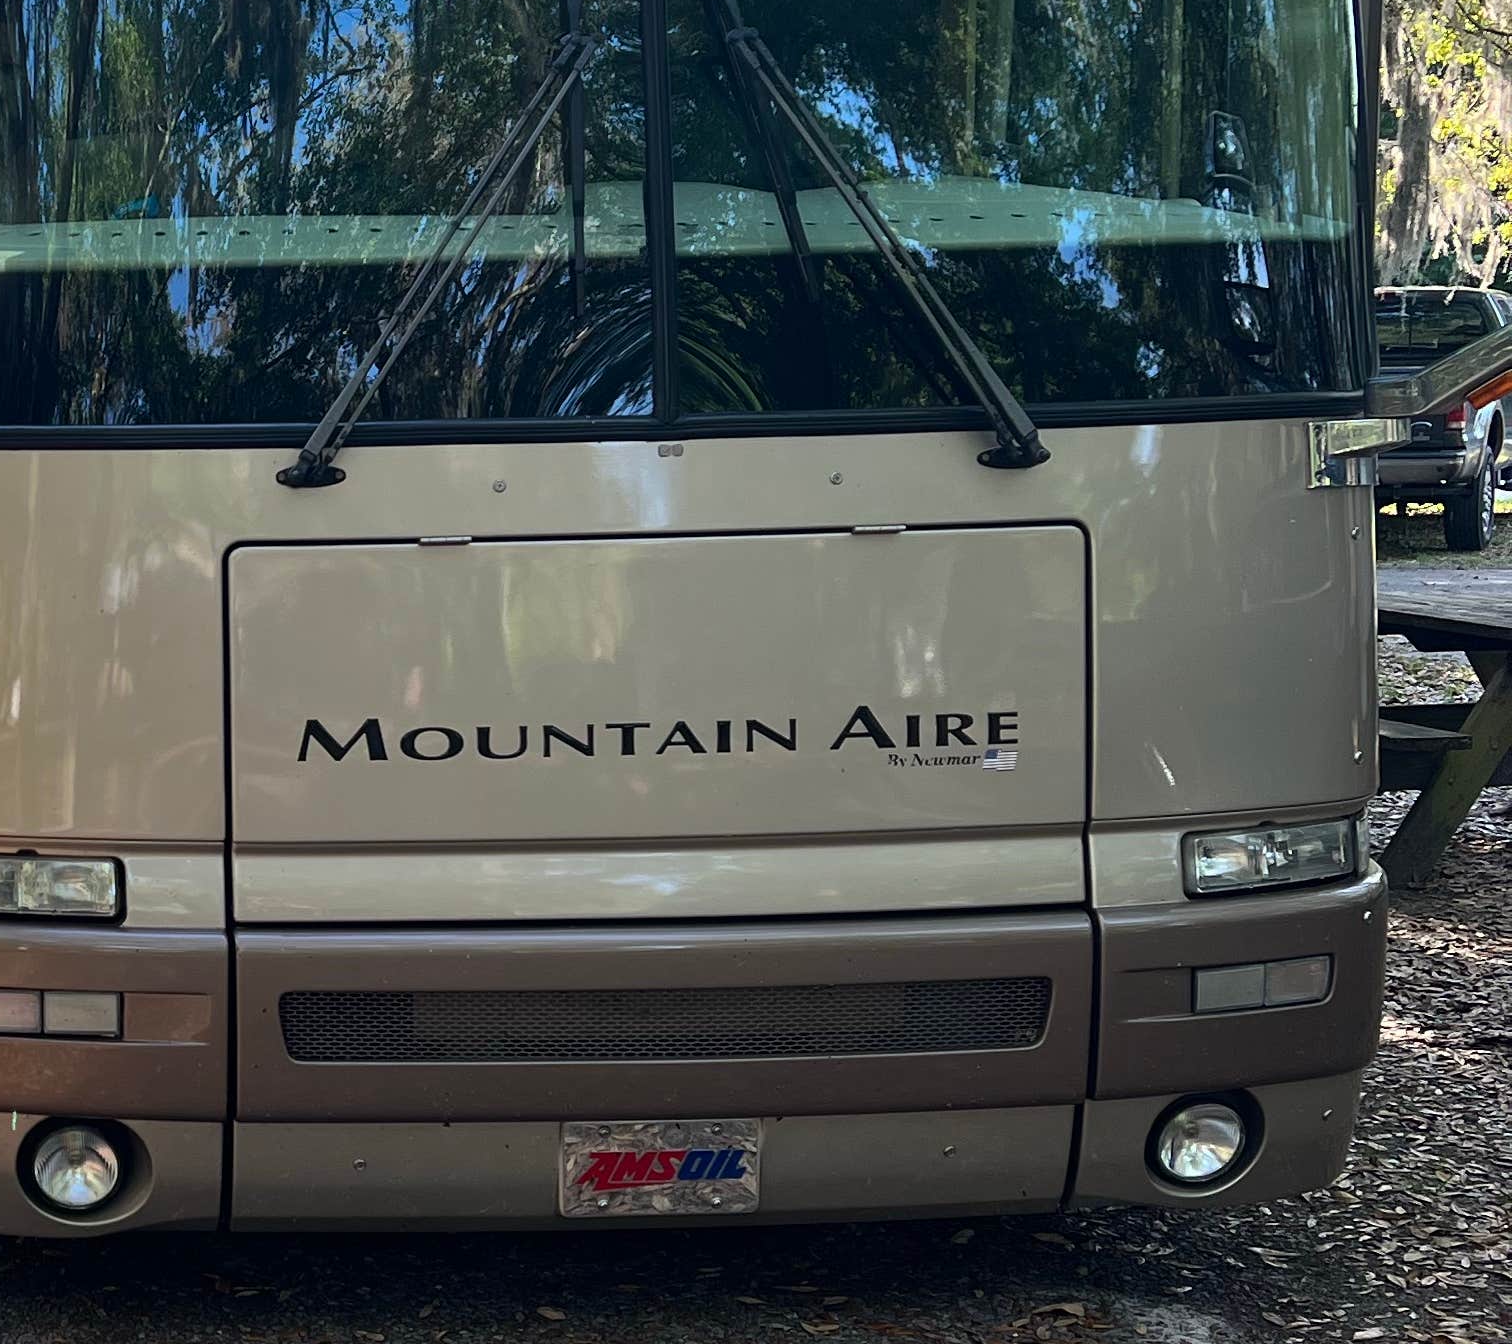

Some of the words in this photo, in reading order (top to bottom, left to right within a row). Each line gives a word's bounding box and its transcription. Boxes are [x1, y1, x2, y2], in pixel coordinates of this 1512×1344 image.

[297, 717, 796, 762] MOUNTAIN
[829, 705, 1019, 751] AIRE
[911, 753, 981, 767] Newmar
[575, 1149, 747, 1191] AMSOIL
